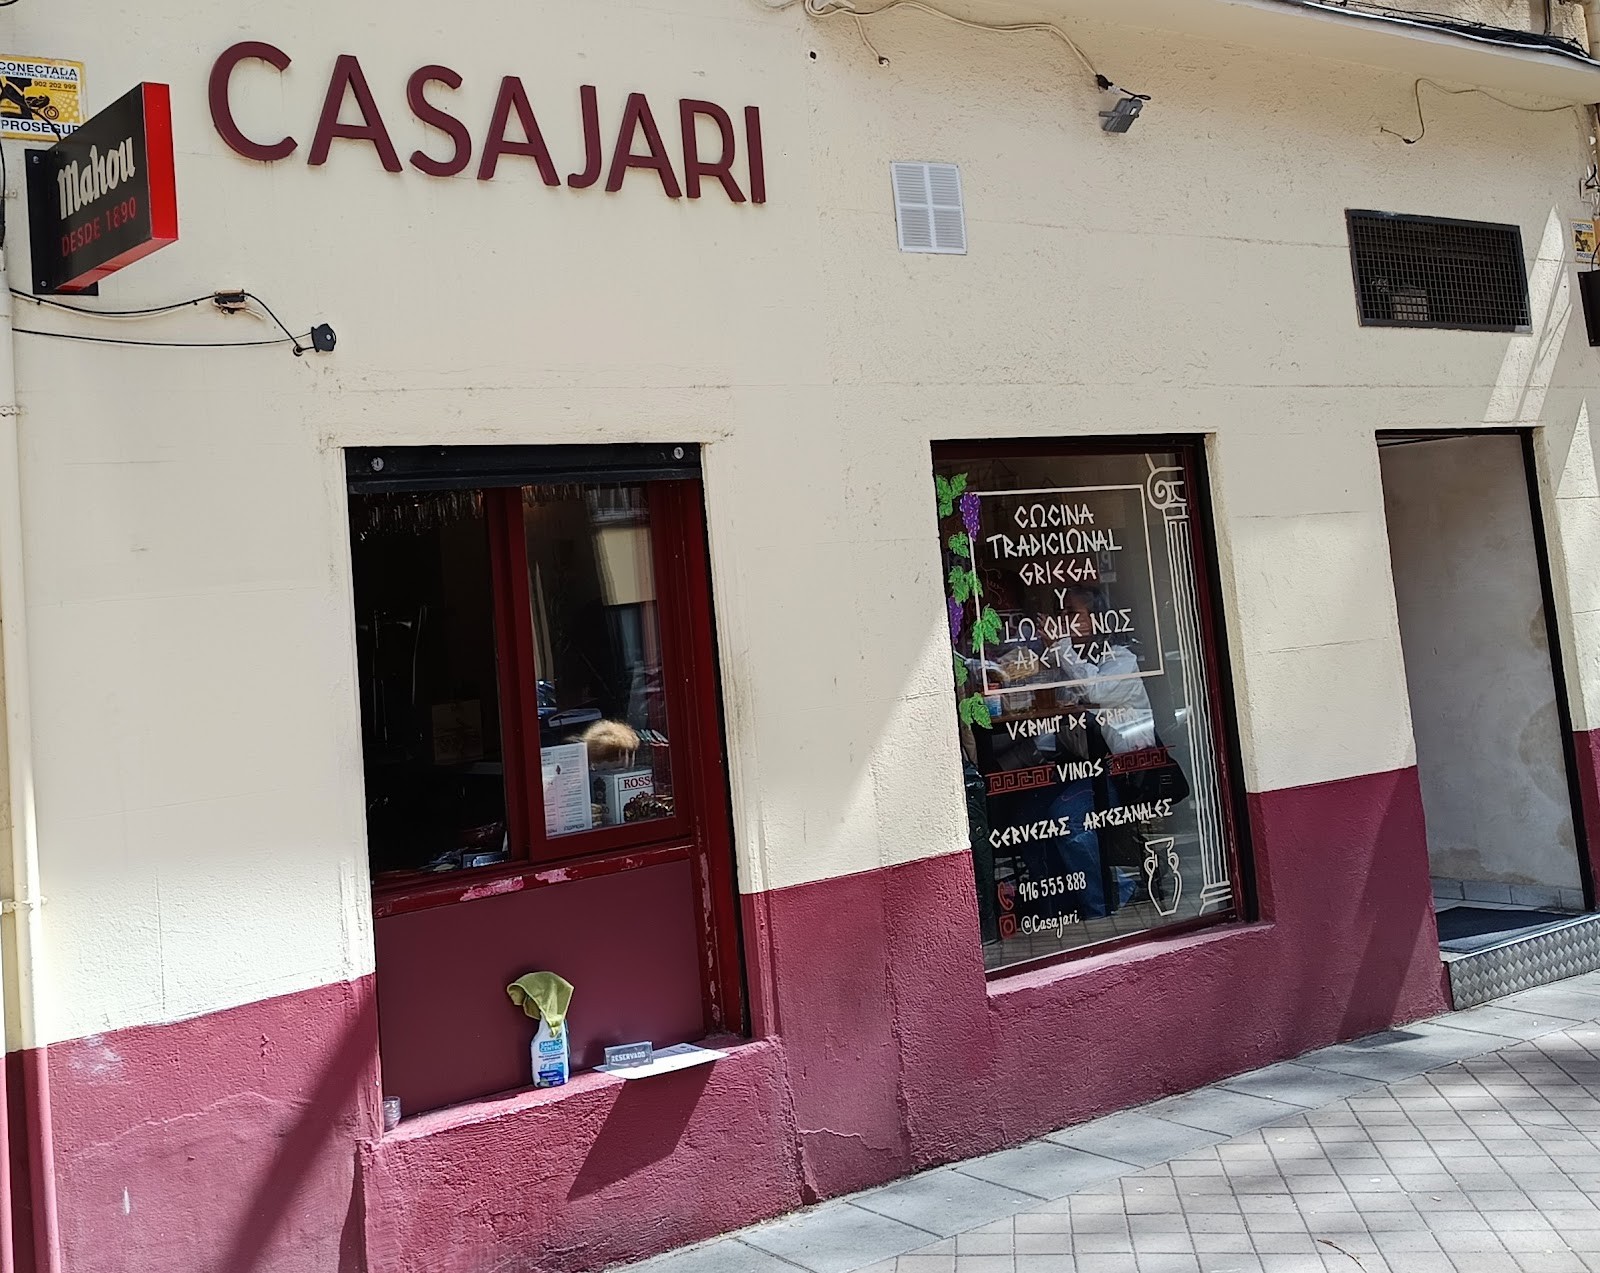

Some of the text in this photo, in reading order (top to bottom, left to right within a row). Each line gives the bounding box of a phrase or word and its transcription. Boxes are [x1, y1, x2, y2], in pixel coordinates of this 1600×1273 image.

[0, 61, 77, 77] CONECTADA
[208, 41, 766, 204] CASAJARI
[57, 137, 135, 220] Mahou
[62, 196, 136, 257] DESDE 1890
[1018, 557, 1097, 586] GRIEGA
[1054, 587, 1068, 610] Y
[1043, 612, 1083, 640] QUE
[1014, 640, 1117, 671] APETEZCA
[1006, 714, 1062, 740] VERMUT
[1068, 711, 1087, 729] DE
[1018, 871, 1087, 902] 916 555 888
[1020, 909, 1081, 938] @Casajari
[610, 1051, 646, 1063] RESERVADO
